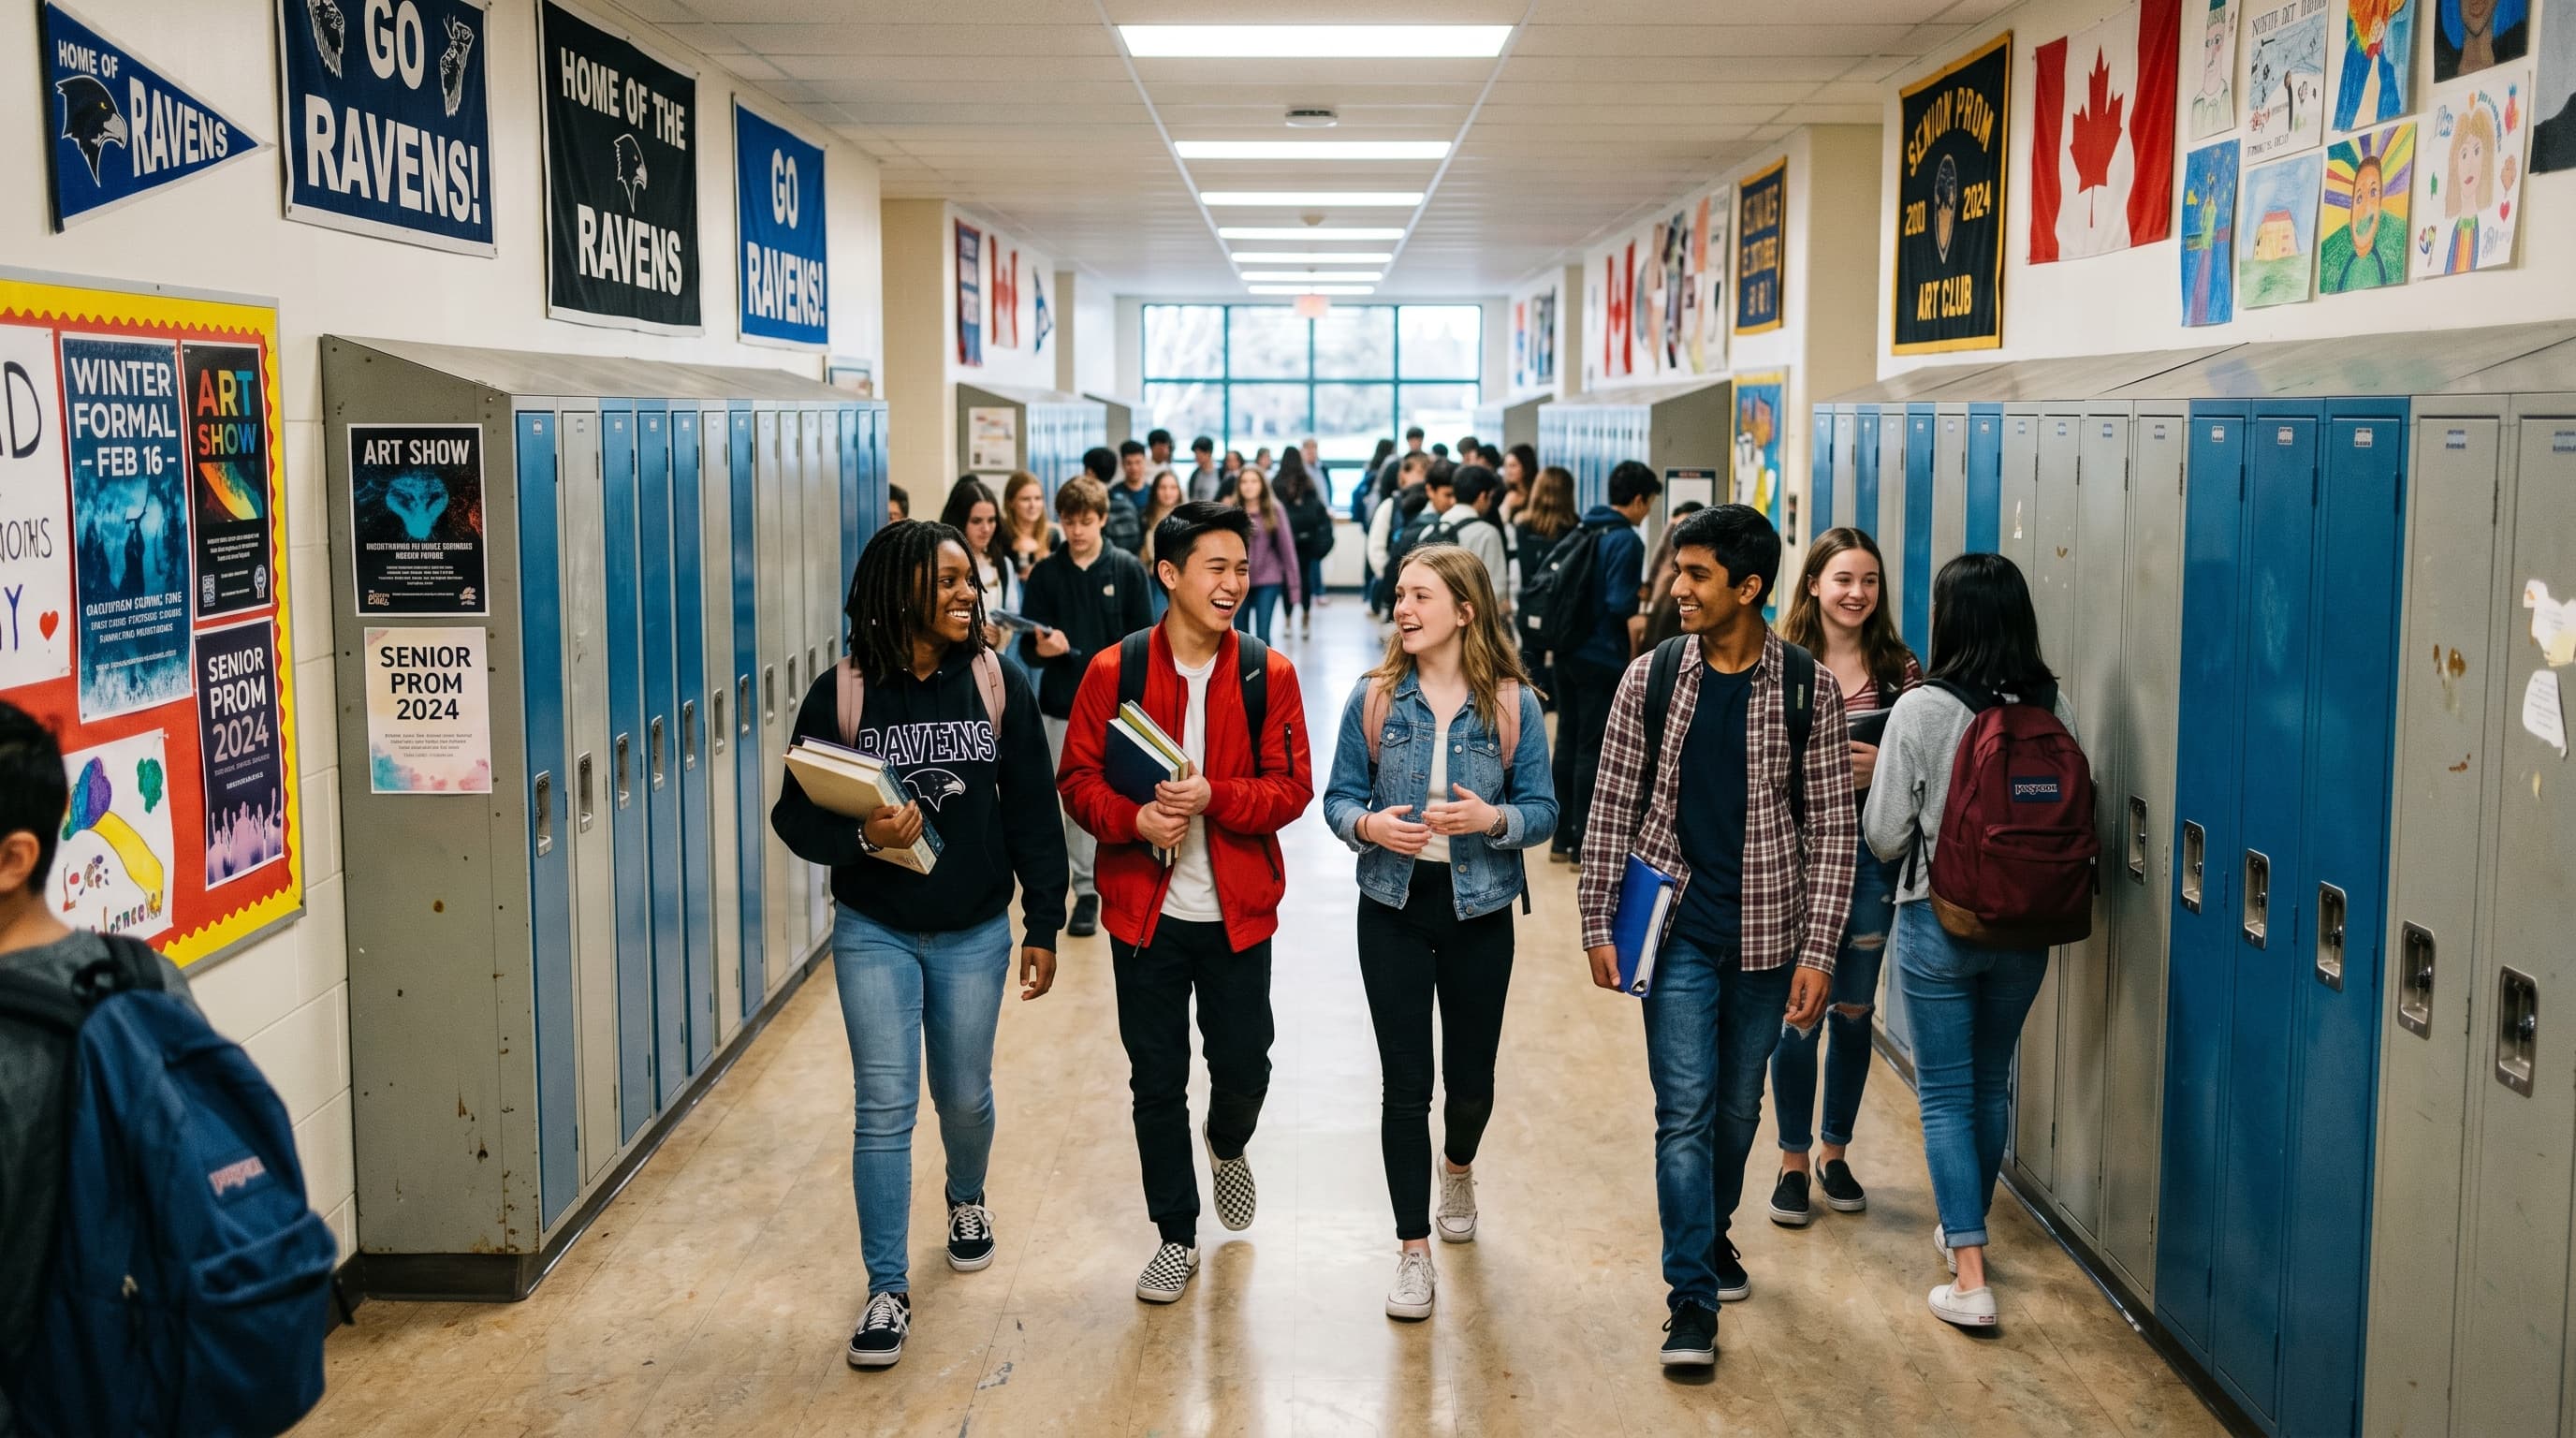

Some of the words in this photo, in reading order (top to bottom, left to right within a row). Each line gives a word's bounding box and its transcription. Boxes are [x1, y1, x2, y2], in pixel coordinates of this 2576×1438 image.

[58, 39, 97, 75] HOME
[100, 55, 118, 79] OF
[364, 0, 424, 90] GO
[562, 47, 620, 118] HOME
[625, 77, 648, 130] OF
[652, 92, 686, 151] THE
[1955, 86, 1995, 154] PROM
[129, 76, 228, 177] RAVENS
[305, 94, 481, 224] RAVENS!
[771, 148, 798, 229] GO
[1962, 179, 1991, 222] 2024
[578, 203, 682, 296] RAVENS
[747, 241, 825, 327] RAVENS!
[1917, 281, 1940, 321] ART
[1941, 274, 1972, 318] CLUB
[70, 358, 172, 397] WINTER
[197, 369, 254, 417] ART
[74, 403, 176, 439] FORMAL
[198, 423, 256, 456] SHOW
[96, 447, 138, 477] FEB
[142, 446, 163, 475] 16
[363, 439, 402, 465] ART
[409, 439, 470, 465] SHOW
[208, 647, 265, 682] SENIOR
[380, 646, 472, 668] SENIOR
[210, 675, 267, 720] PROM
[391, 672, 462, 694] PROM
[397, 698, 460, 720] 2024
[212, 712, 270, 763] 2024
[859, 720, 996, 766] RAVENS
